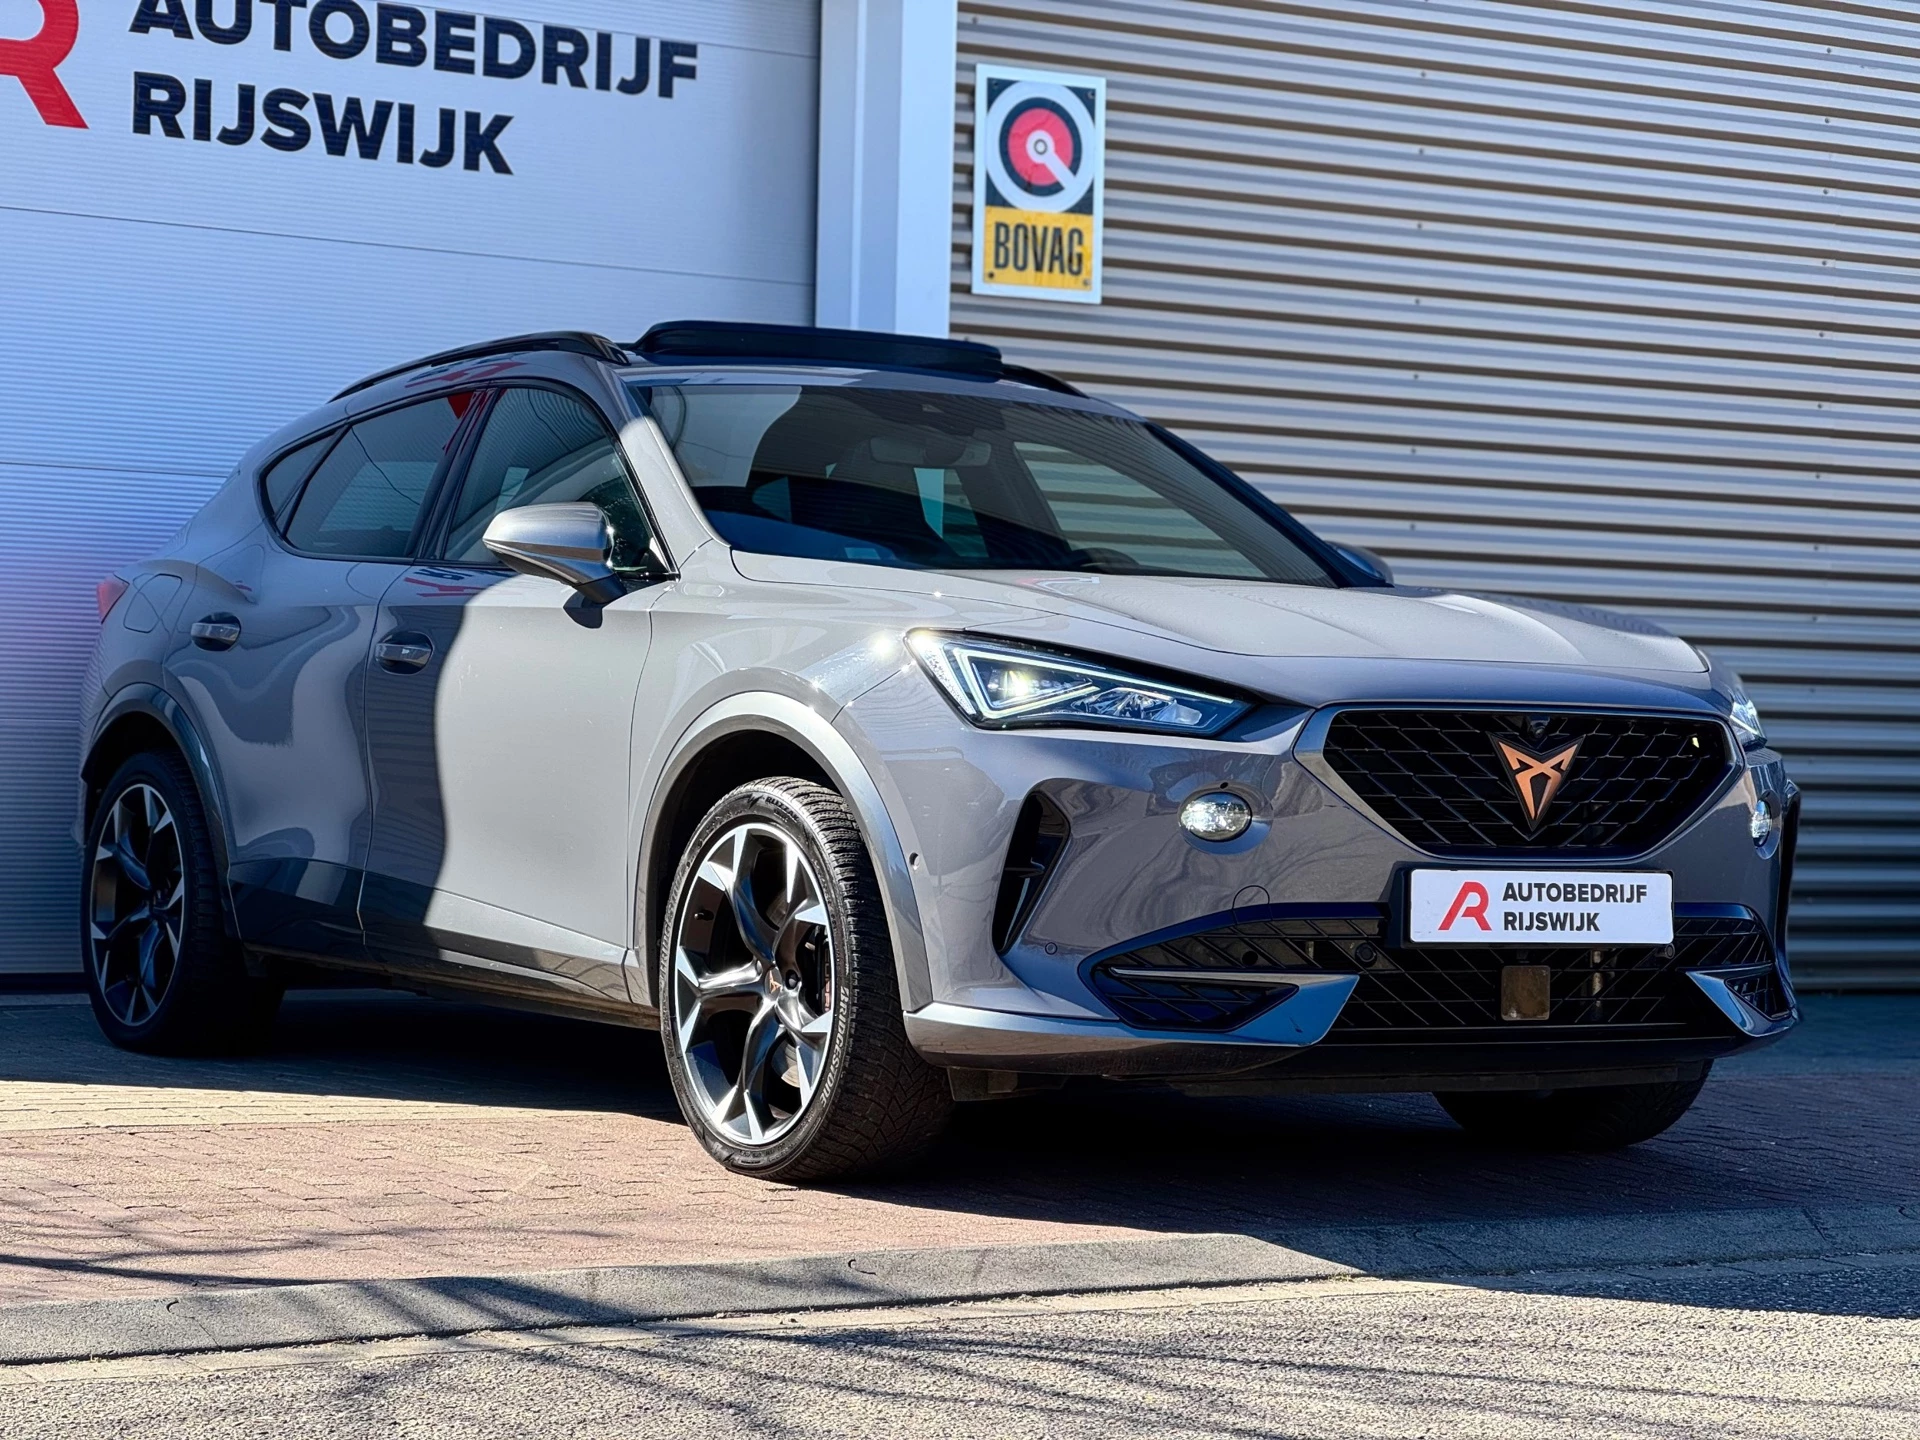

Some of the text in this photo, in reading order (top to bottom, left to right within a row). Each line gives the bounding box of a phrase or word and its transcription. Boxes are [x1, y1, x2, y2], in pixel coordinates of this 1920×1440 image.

[129, 0, 698, 99] AUTOBEDRIJF
[132, 71, 514, 176] RIJSWIJK
[993, 221, 1084, 276] BOVAG
[1502, 882, 1648, 903] AUTOBEDRIJF
[1503, 911, 1600, 932] RIJSWIJK
[820, 985, 850, 1108] BRIDGESTONE
